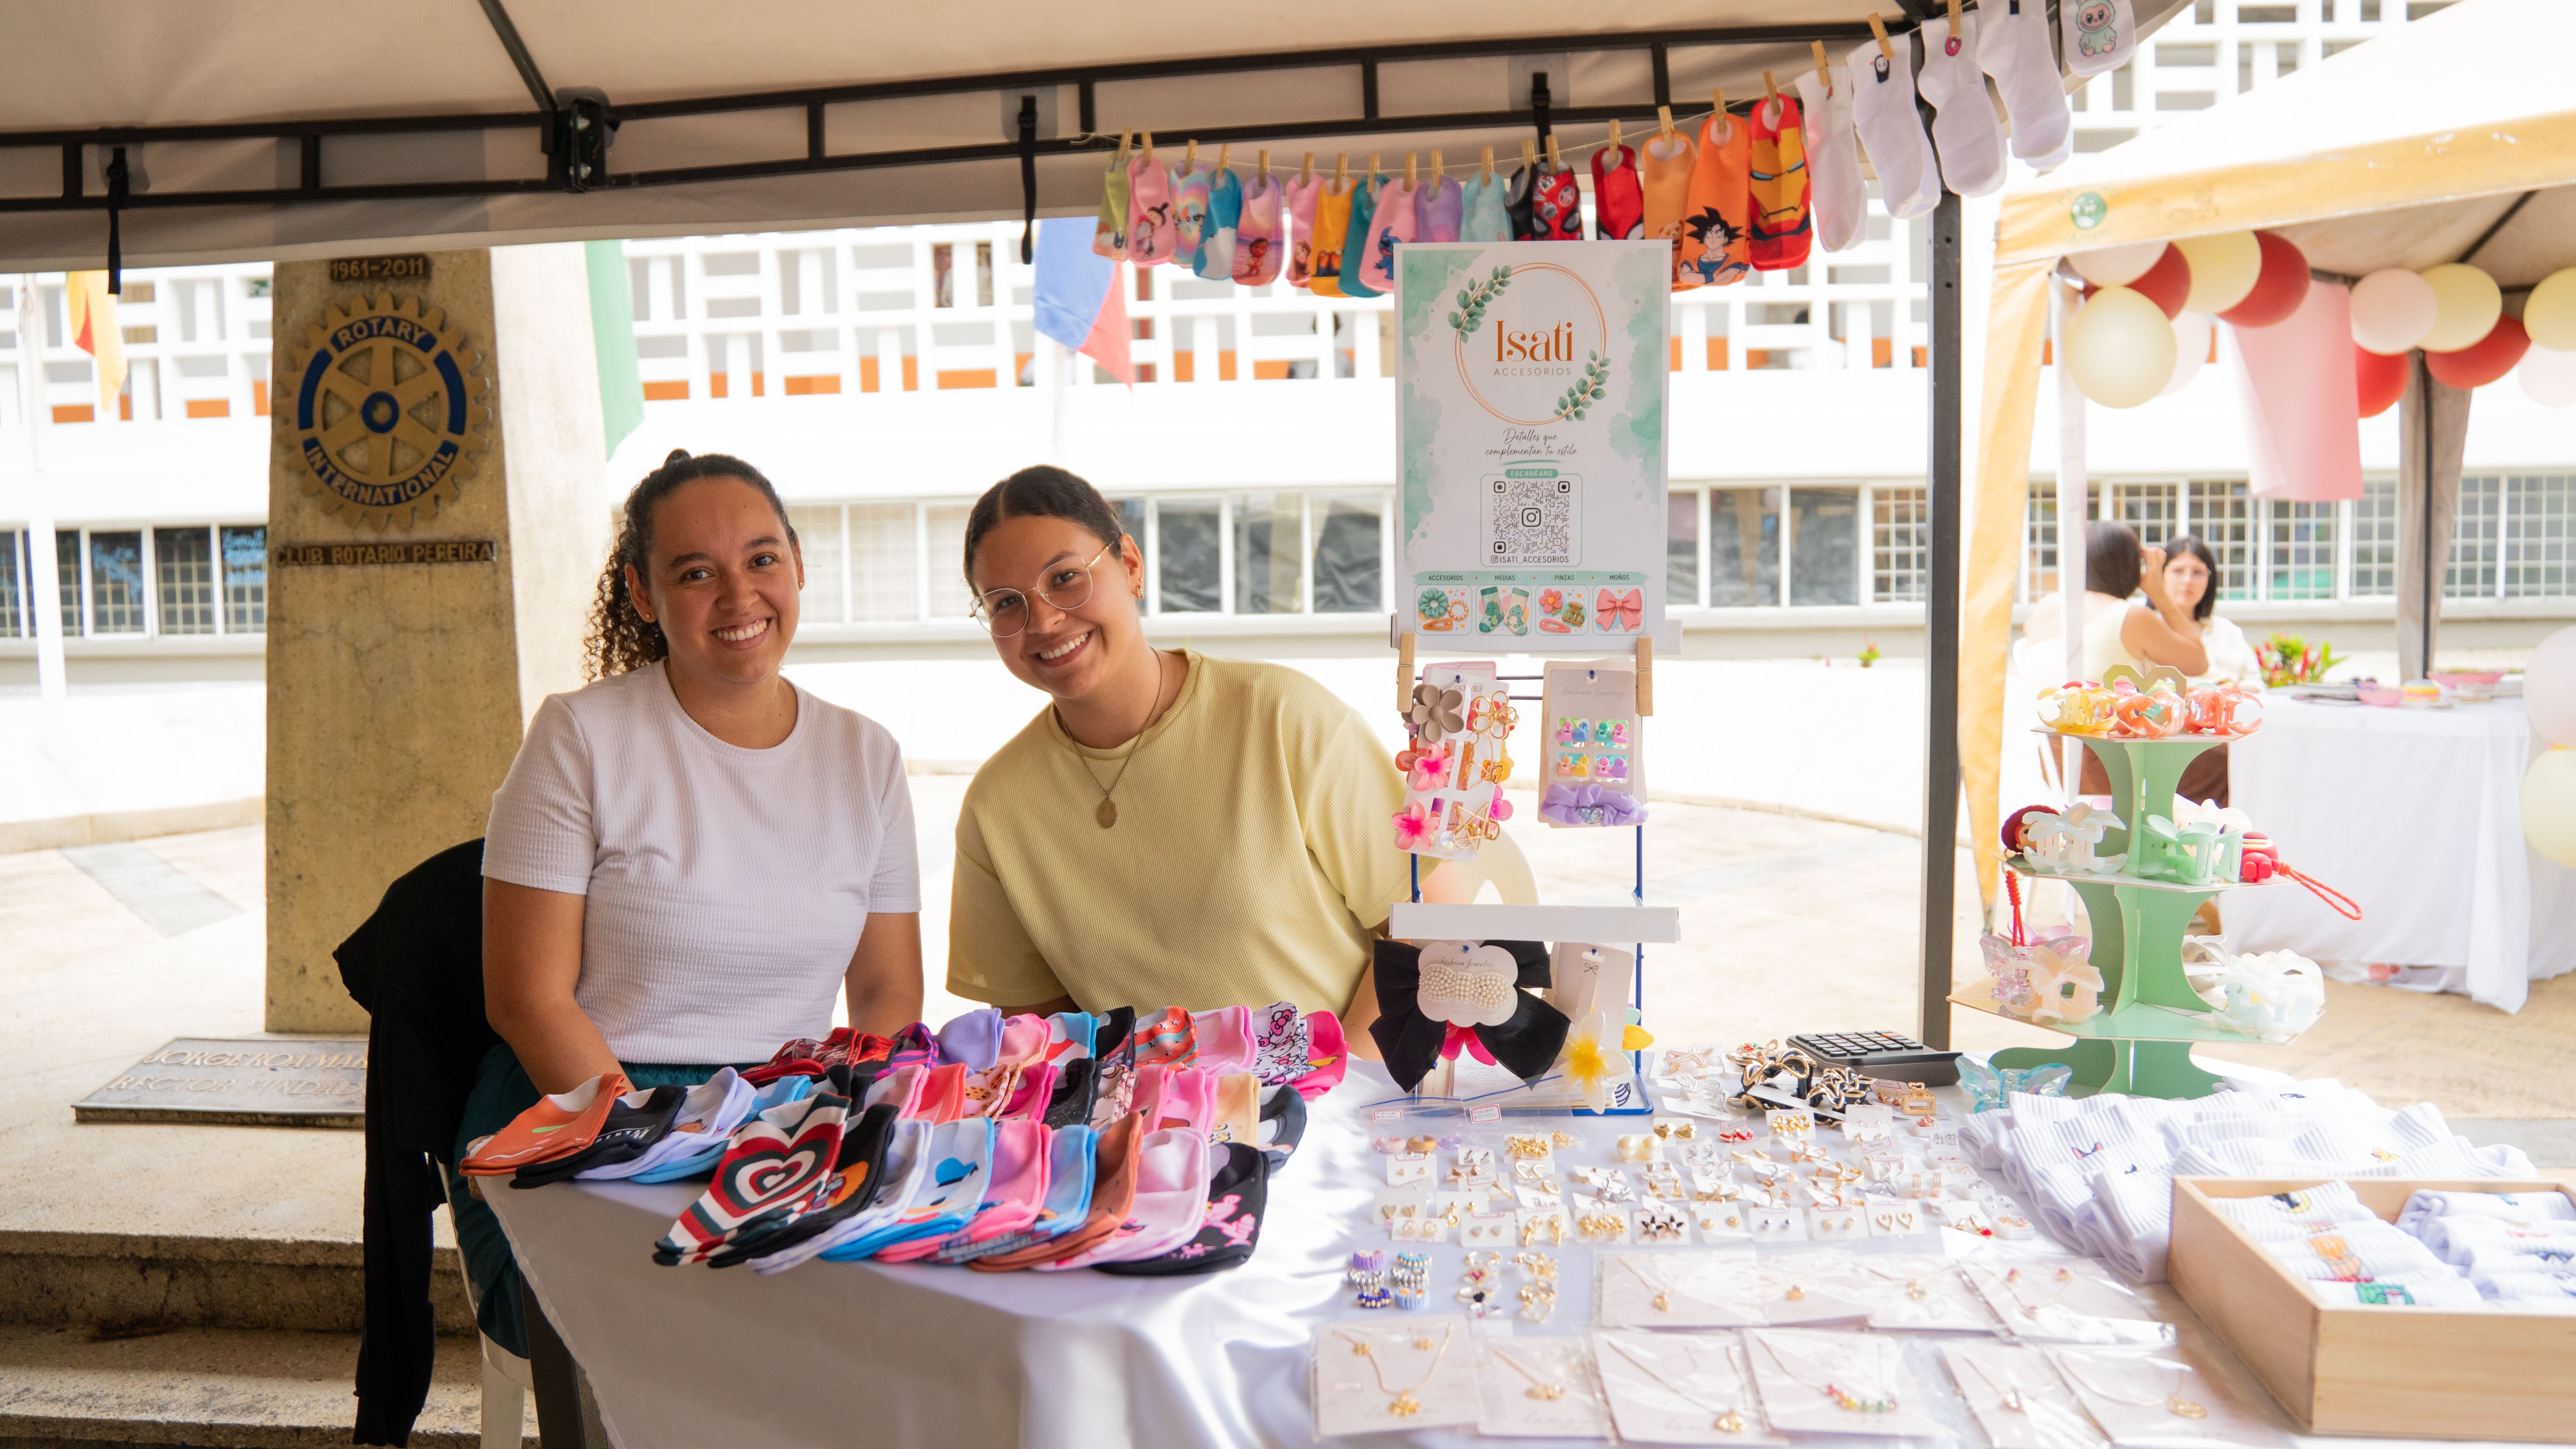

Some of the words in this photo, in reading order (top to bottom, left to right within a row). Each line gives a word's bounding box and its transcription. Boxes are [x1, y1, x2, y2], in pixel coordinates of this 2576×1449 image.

[330, 258, 424, 279] 1961-2011
[339, 318, 428, 346] ROTARY
[1496, 320, 1573, 362] Isati
[1494, 367, 1571, 376] ACCESORIOS
[1503, 428, 1540, 444] Detalles
[1543, 433, 1558, 445] que
[1485, 445, 1542, 460] complementan
[1546, 444, 1554, 456] tu
[308, 447, 453, 505] INTERNATIONAL
[277, 547, 323, 565] CLUB
[332, 545, 405, 563] ROTARIO
[412, 543, 492, 561] PEREIRA
[1561, 687, 1591, 695] Fashion
[1593, 687, 1625, 698] Jewelry
[1441, 957, 1464, 966] Fashion
[1465, 958, 1494, 968] Jewelry
[142, 1051, 252, 1067] JORGE
[108, 1076, 236, 1093] RECTOR
[237, 1079, 367, 1095] FUNDAD
